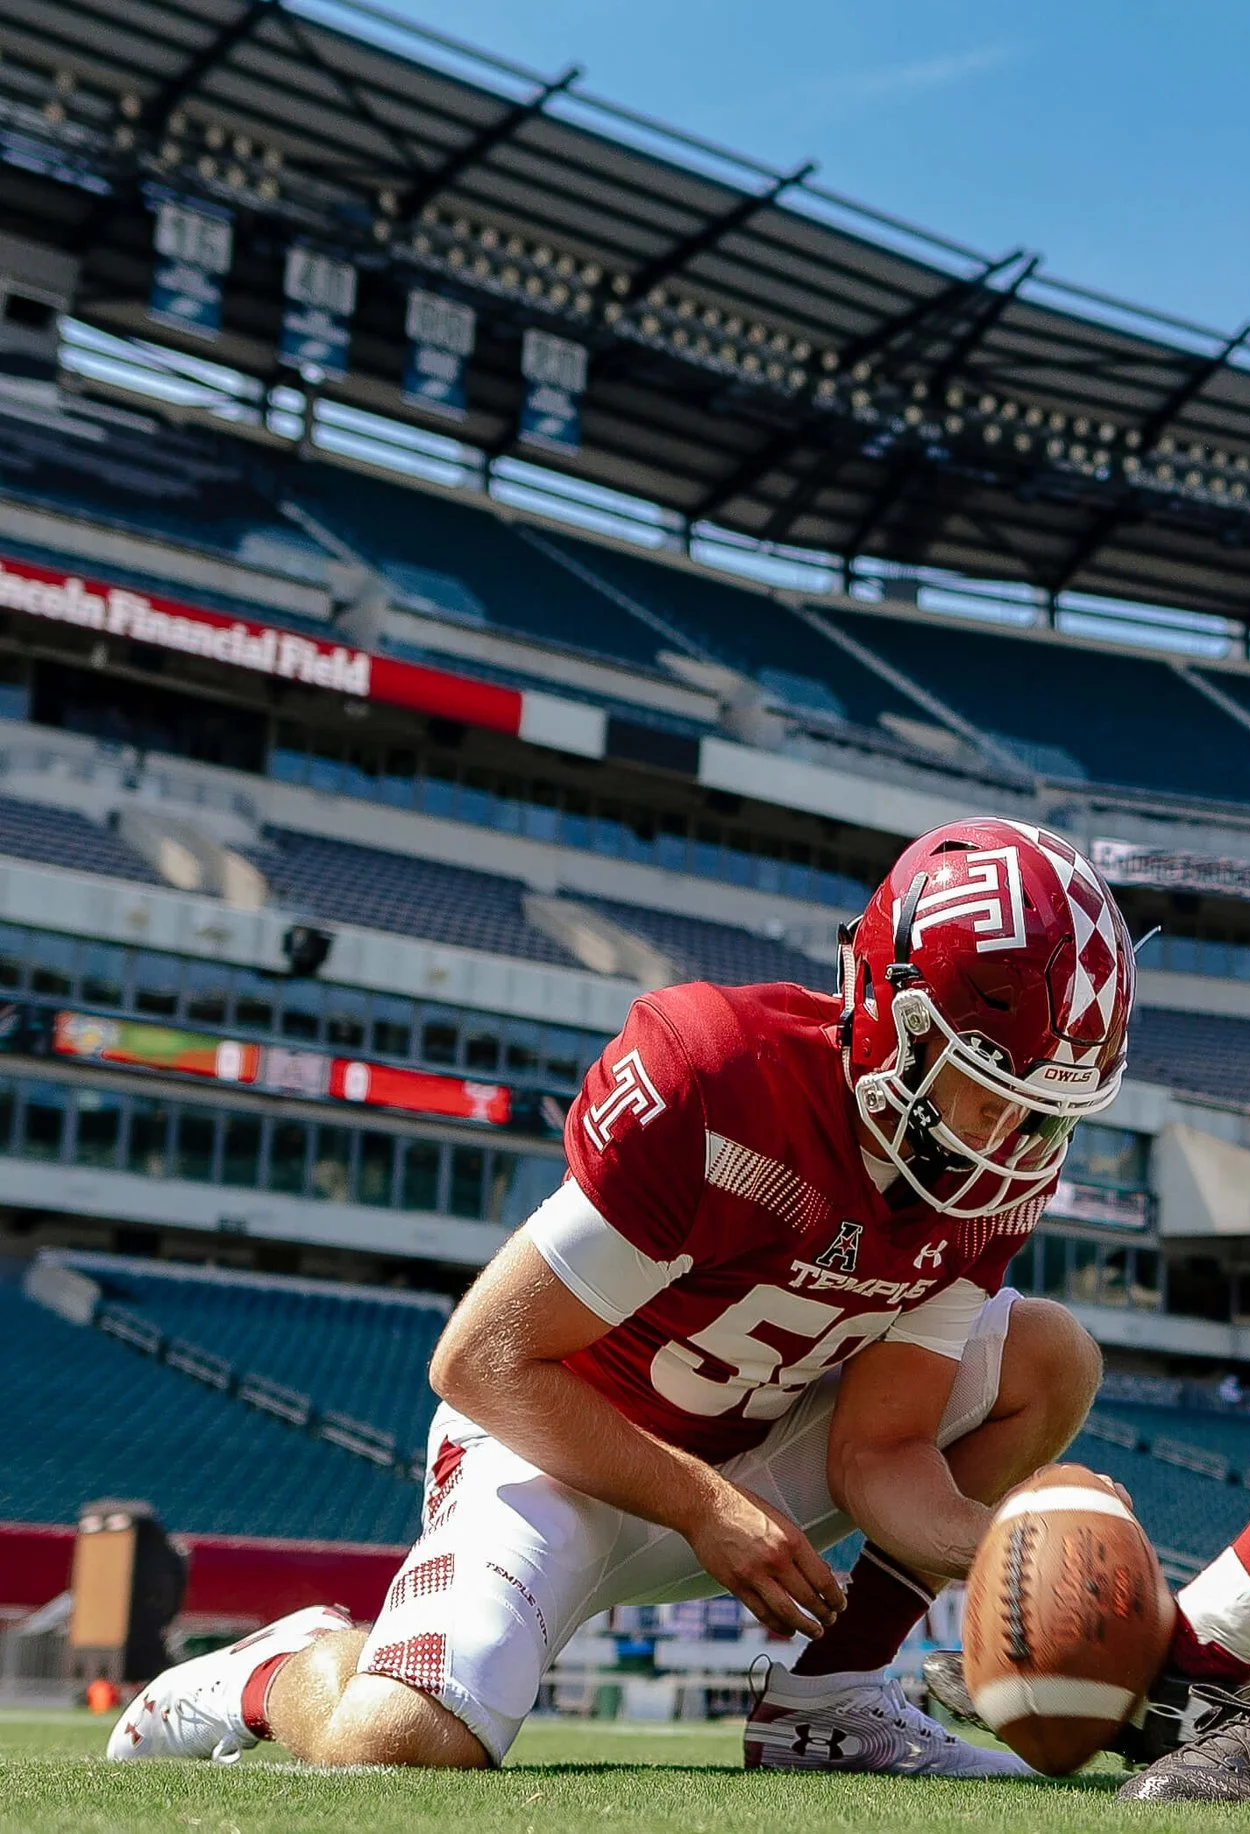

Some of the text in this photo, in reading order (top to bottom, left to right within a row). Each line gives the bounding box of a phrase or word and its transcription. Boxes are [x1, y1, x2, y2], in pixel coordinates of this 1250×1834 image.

[1044, 1068, 1093, 1083] OWLS
[787, 1258, 938, 1305] TEMPLE
[485, 1561, 537, 1607] TEMPLE
